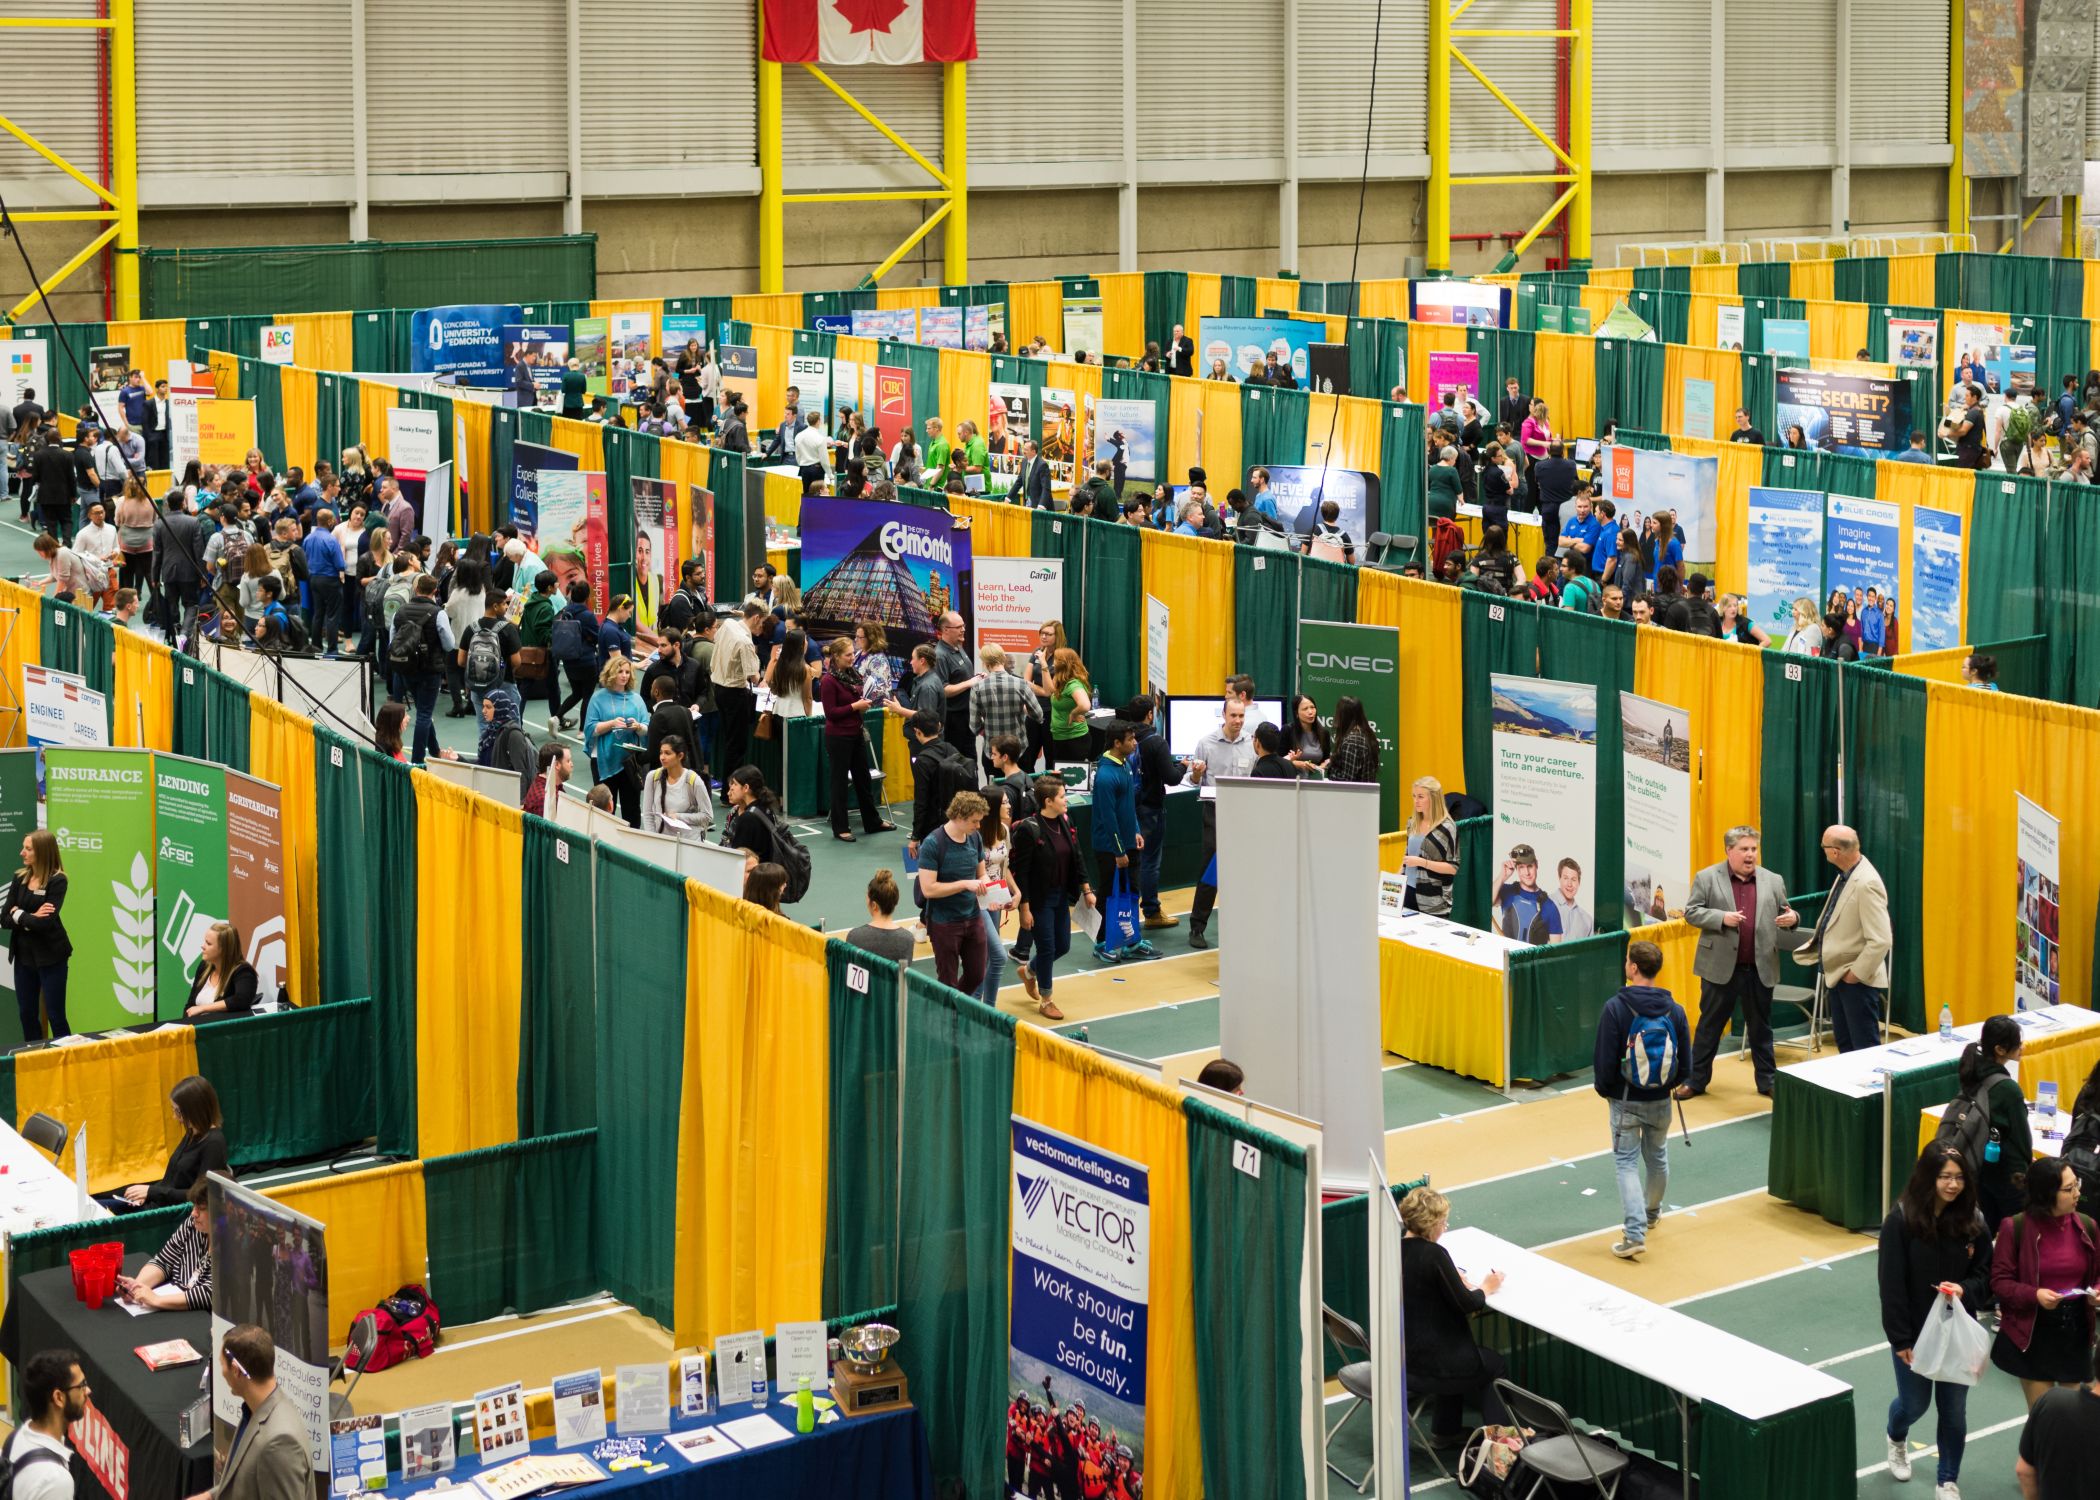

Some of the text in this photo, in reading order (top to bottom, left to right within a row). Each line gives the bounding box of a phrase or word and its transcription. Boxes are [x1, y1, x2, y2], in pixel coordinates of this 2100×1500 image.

[443, 320, 480, 328] CONCORDIA
[443, 328, 493, 337] UNIVERSITY
[267, 330, 291, 347] ABC
[449, 336, 499, 346] EDMONTON
[457, 361, 487, 369] CANADA'S
[469, 368, 504, 376] UNIVERSITY
[792, 361, 824, 374] SED
[882, 381, 903, 396] CIBC
[1821, 390, 1890, 412] SECRET?
[199, 432, 236, 440] OUR TEAM
[398, 426, 433, 435] Husky Energy
[2003, 482, 2014, 493] 115
[1844, 506, 1894, 520] BLUE CROSS
[907, 525, 916, 533] THE
[916, 526, 925, 535] CITY
[1838, 525, 1871, 541] Imagine
[594, 542, 602, 567] Lives
[1839, 540, 1881, 553] your future
[1846, 554, 1865, 564] Alberta
[1030, 570, 1057, 581] Cargill
[594, 568, 604, 615] Enriching
[978, 582, 1033, 594] Learn, Lead,
[978, 593, 1015, 603] Help the
[978, 603, 1031, 613] world thrive
[1492, 606, 1503, 620] 92
[1307, 652, 1395, 674] ONEC
[1308, 674, 1360, 686] OnecGroup.com
[1788, 665, 1799, 680] 93
[74, 722, 98, 741] CAREERS
[333, 748, 341, 765] 68
[1501, 749, 1577, 769] Turn your career
[51, 766, 143, 783] INSURANCE
[1501, 758, 1585, 780] into an adventure.
[157, 773, 210, 796] LENDING
[1626, 770, 1667, 793] Think outside
[1626, 781, 1663, 801] the cubicle.
[229, 792, 279, 819] AGRISTABILITY
[1512, 817, 1556, 831] NorthwesTel
[57, 836, 103, 850] AFSC
[558, 841, 568, 862] 69
[160, 846, 194, 864] AFSC
[852, 966, 864, 990] 70
[1025, 1135, 1130, 1190] vectormarketing.ca
[1241, 1145, 1256, 1174] 71
[1050, 1175, 1137, 1217] THE PREMIER STUDENT OPPORTUNITY
[1051, 1185, 1135, 1253] VECTOR
[1057, 1223, 1124, 1262] Marketing Canada
[1025, 1235, 1044, 1252] Place
[1045, 1244, 1052, 1256] to
[1054, 1249, 1073, 1267] Learn,
[1075, 1258, 1093, 1273] Grow
[1095, 1268, 1109, 1281] and
[1033, 1266, 1135, 1332] Work should
[1073, 1317, 1133, 1364] be fun.
[277, 1354, 321, 1387] Schedules
[1056, 1340, 1131, 1397] Seriously.
[287, 1379, 321, 1408] Training
[223, 1399, 235, 1415] No
